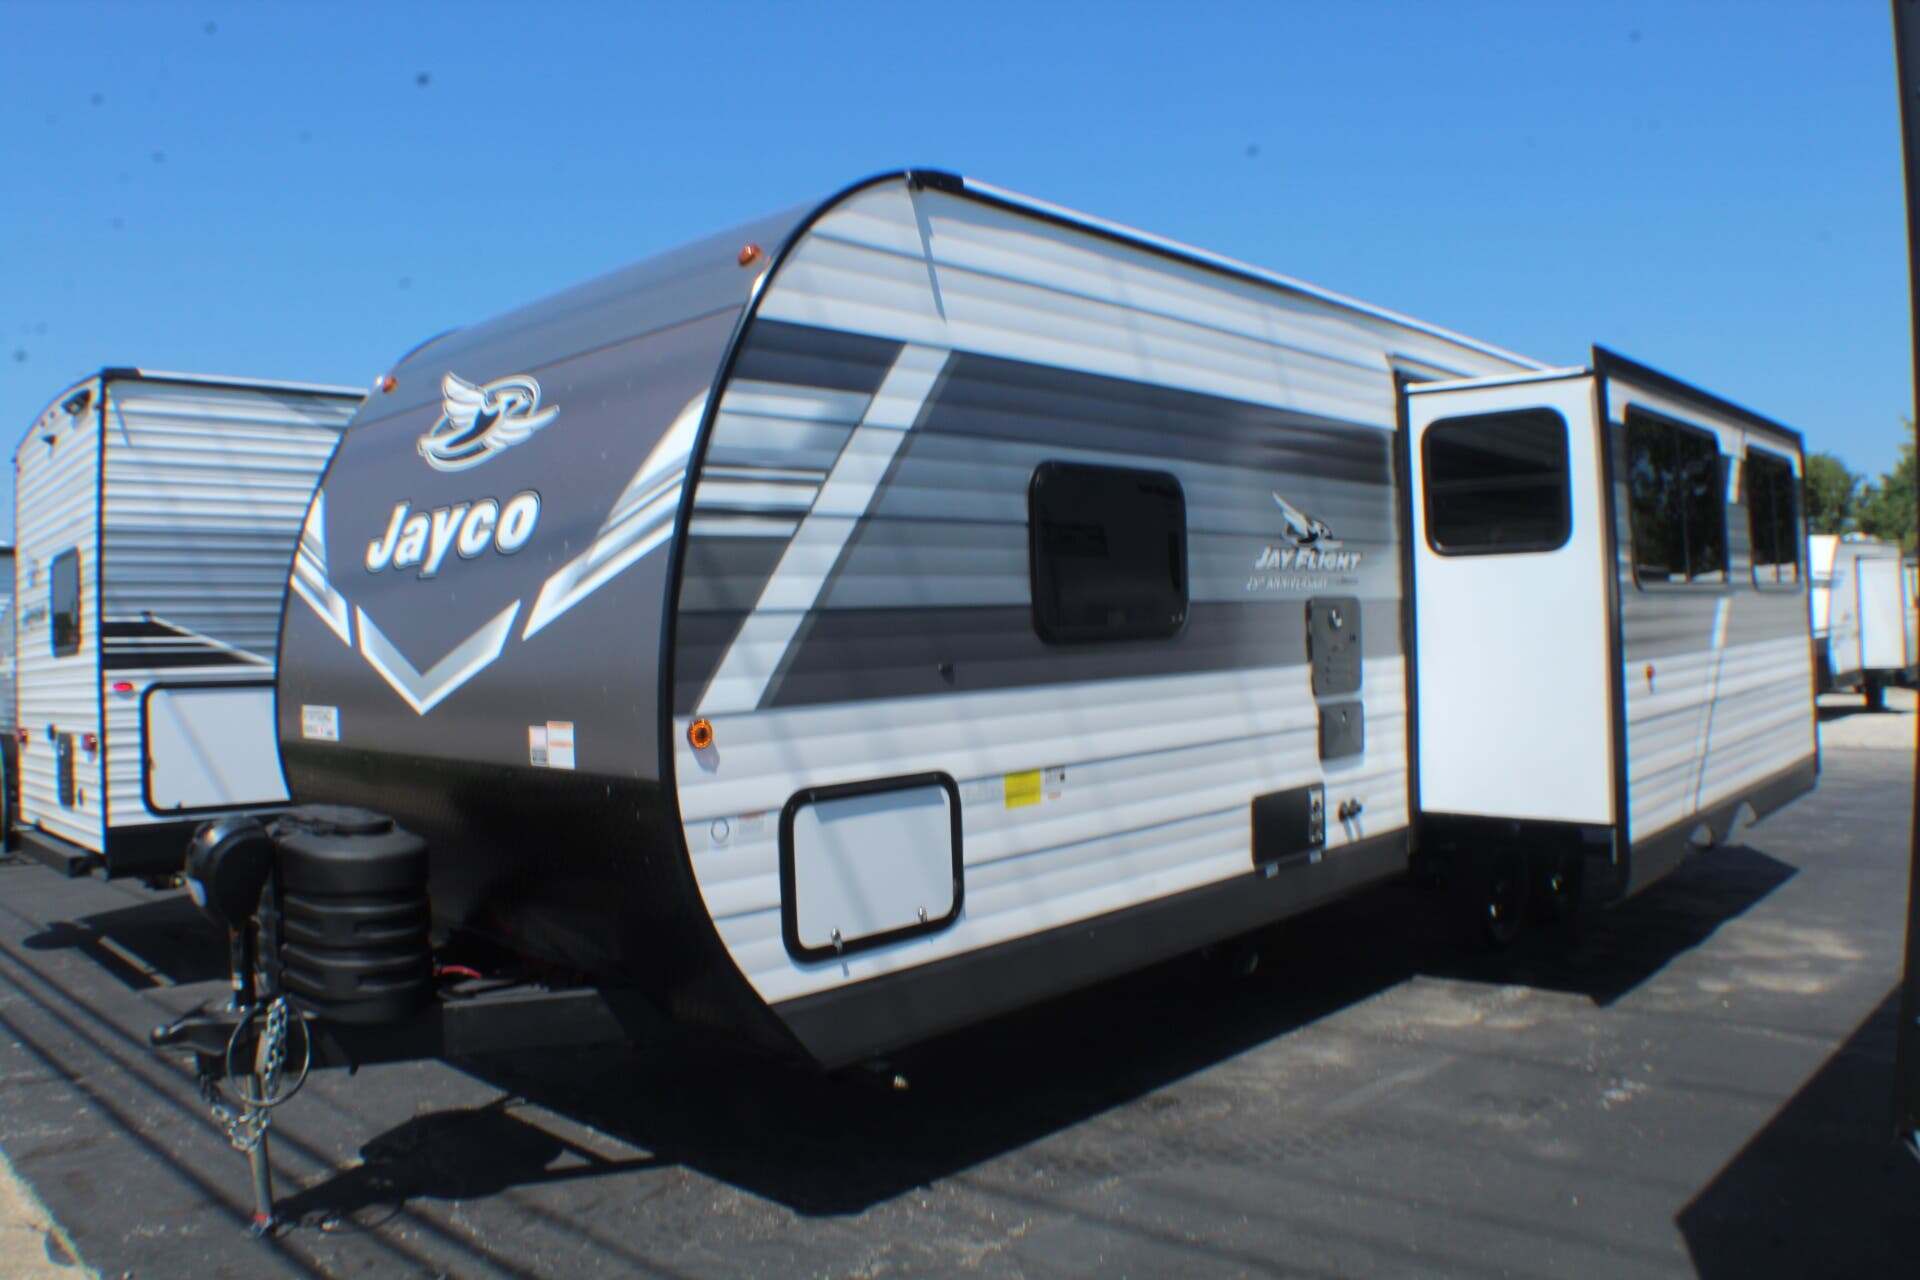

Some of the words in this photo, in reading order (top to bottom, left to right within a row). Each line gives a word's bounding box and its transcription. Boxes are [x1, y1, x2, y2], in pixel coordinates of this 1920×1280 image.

[365, 489, 541, 579] Jayco
[1254, 546, 1296, 571] JAY
[1295, 549, 1362, 571] FLIGHT
